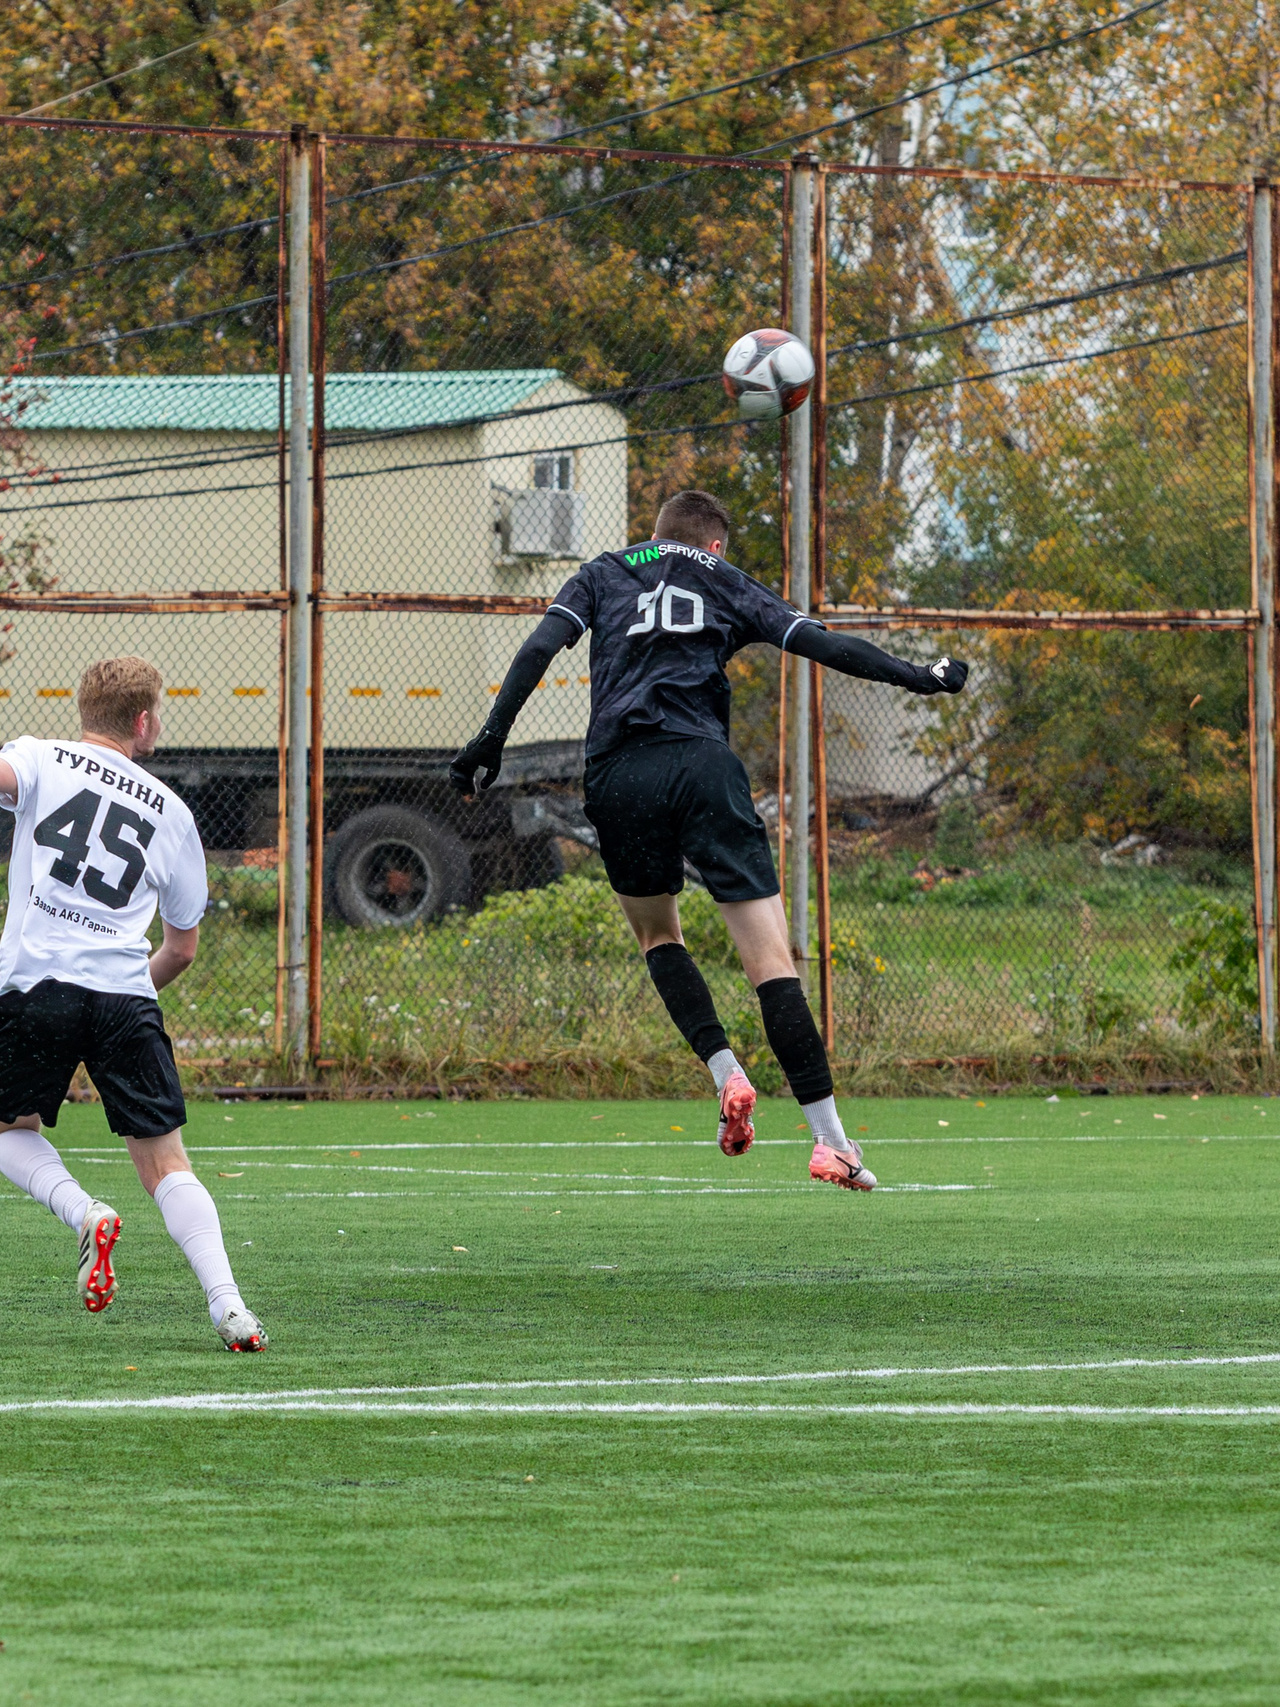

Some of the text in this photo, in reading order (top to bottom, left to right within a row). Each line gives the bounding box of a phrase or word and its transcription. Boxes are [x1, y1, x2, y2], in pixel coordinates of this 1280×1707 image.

[54, 747, 166, 815] ТУРБИНА
[33, 788, 157, 911] 45
[33, 896, 57, 918] Завод
[81, 916, 118, 936] Гарант
